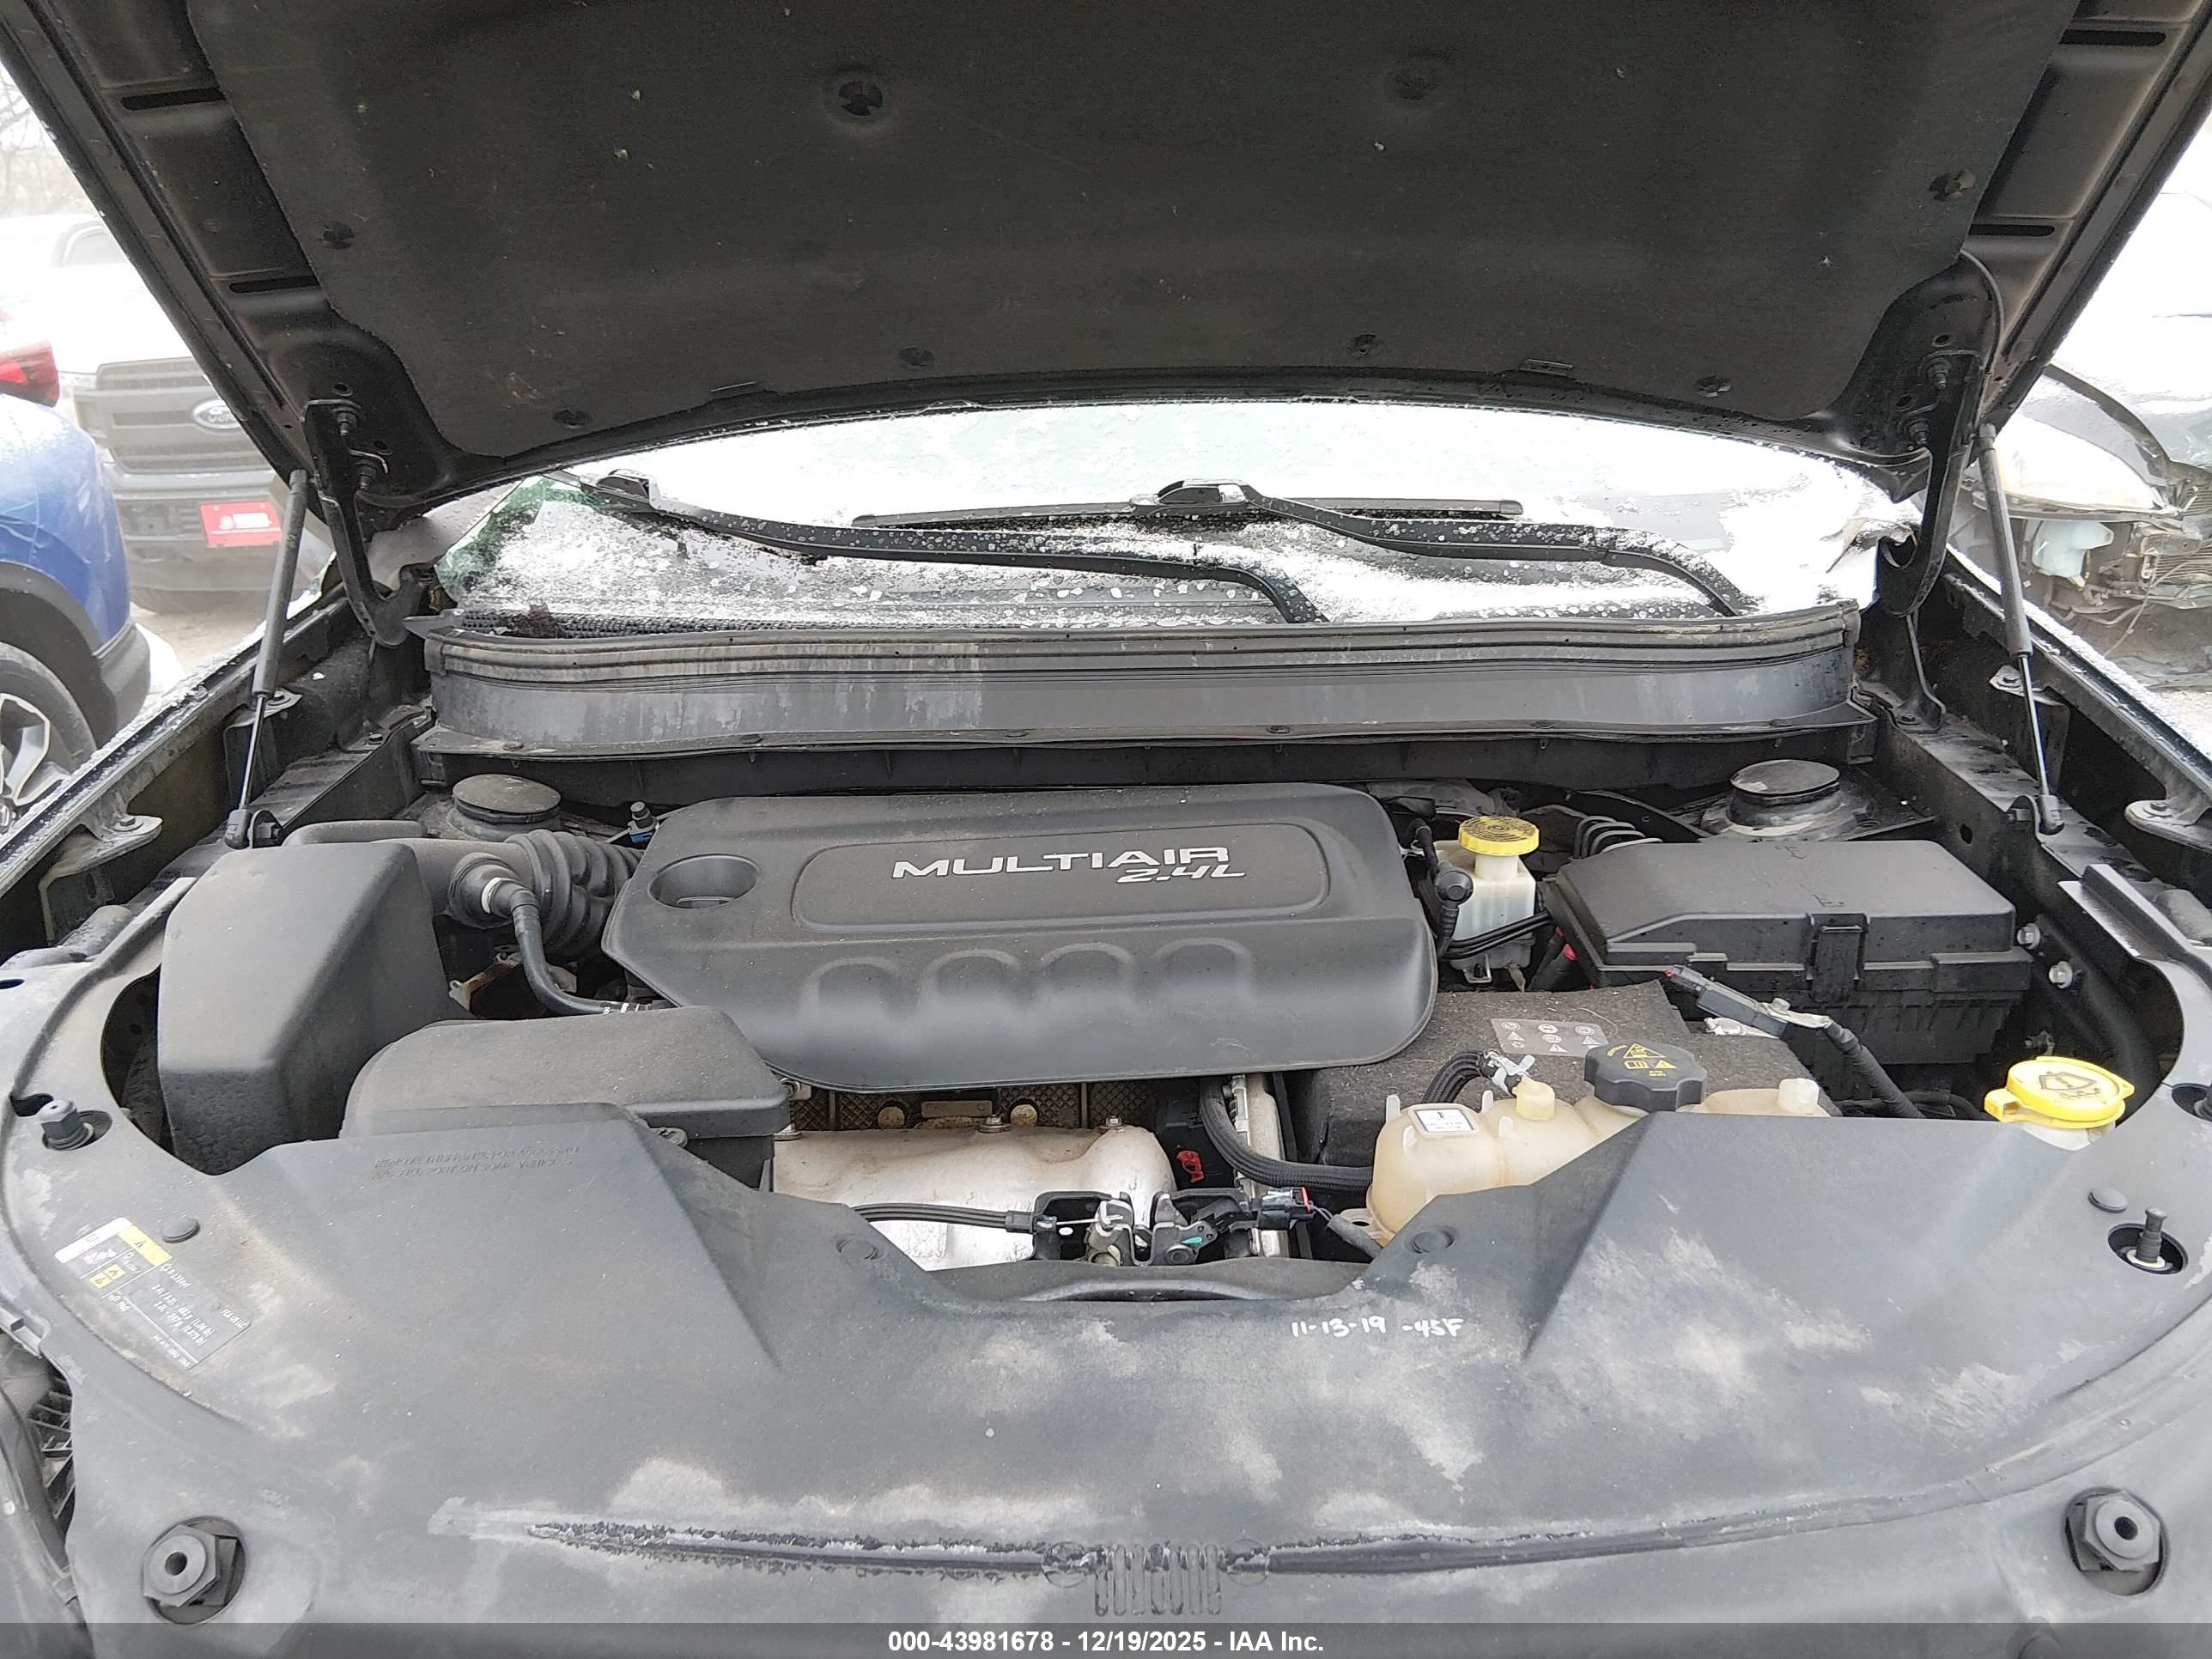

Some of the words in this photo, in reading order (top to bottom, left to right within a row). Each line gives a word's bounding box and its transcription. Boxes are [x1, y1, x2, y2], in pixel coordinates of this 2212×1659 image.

[892, 846, 1230, 878] MULTIAIR
[1115, 864, 1246, 884] 2.4L
[1291, 1315, 1387, 1338] 11-13-19
